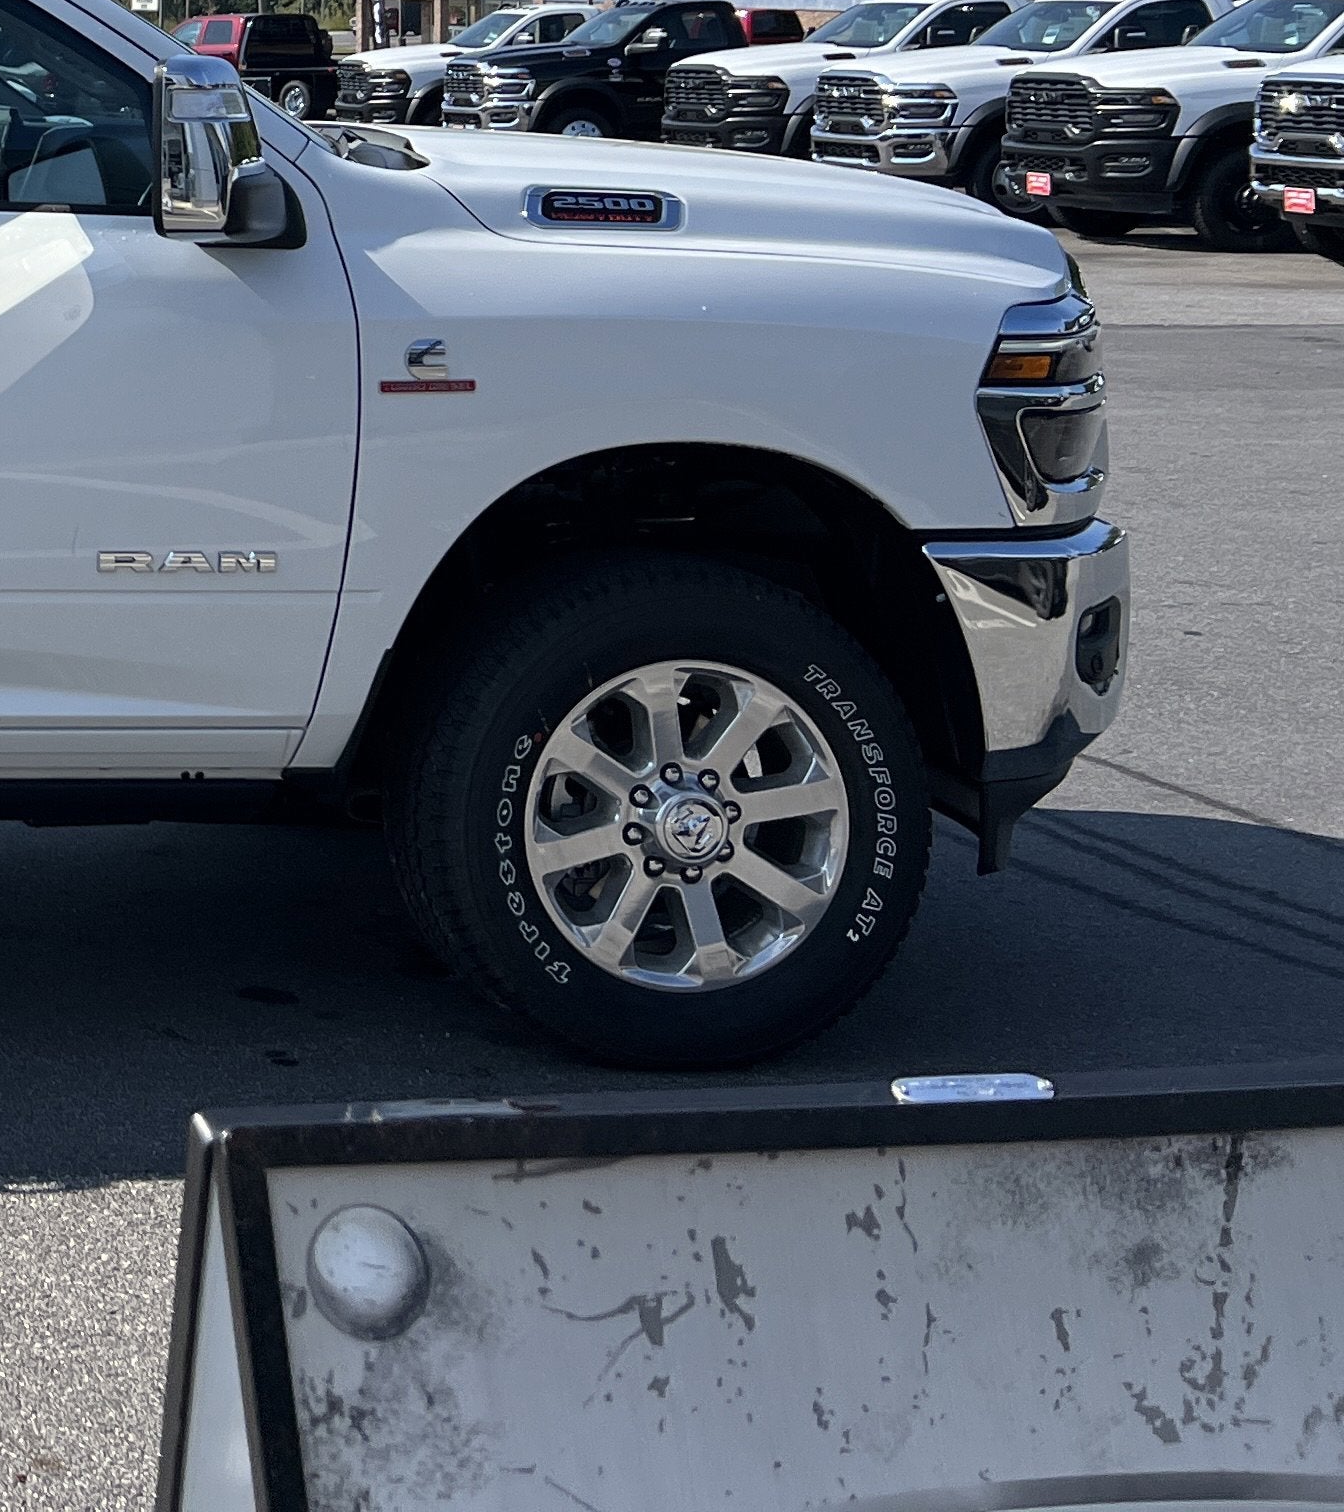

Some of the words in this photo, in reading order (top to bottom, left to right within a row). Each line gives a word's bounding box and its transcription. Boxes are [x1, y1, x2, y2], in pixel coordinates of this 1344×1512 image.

[550, 196, 655, 211] 2500
[97, 550, 279, 573] RAM
[803, 664, 898, 880] TRANSFORCE
